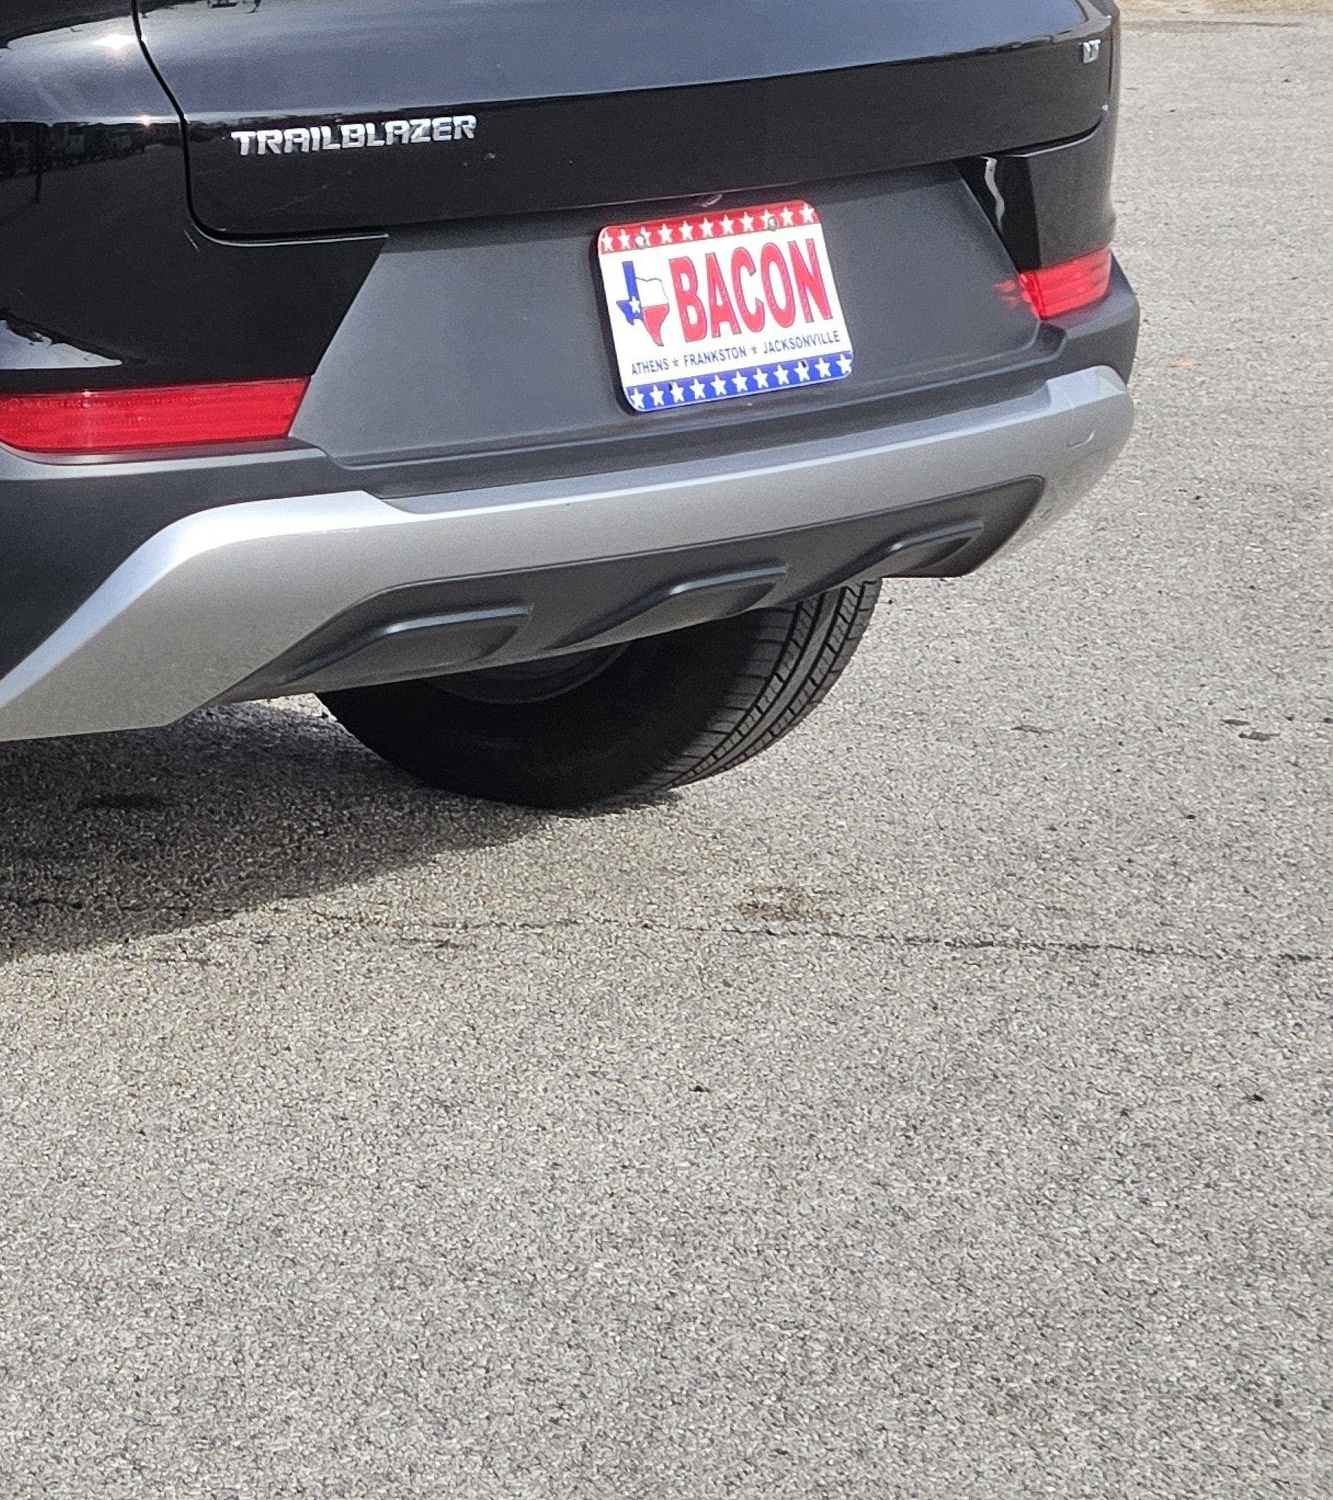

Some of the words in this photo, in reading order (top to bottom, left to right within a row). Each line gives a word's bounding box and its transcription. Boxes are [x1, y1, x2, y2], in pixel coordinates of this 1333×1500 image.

[230, 114, 478, 156] TRAILBLAZER
[669, 238, 833, 342] BACON
[631, 357, 670, 376] ATHENS
[683, 346, 748, 367] FRANKSTON
[763, 330, 842, 355] JACKSONVILLE
